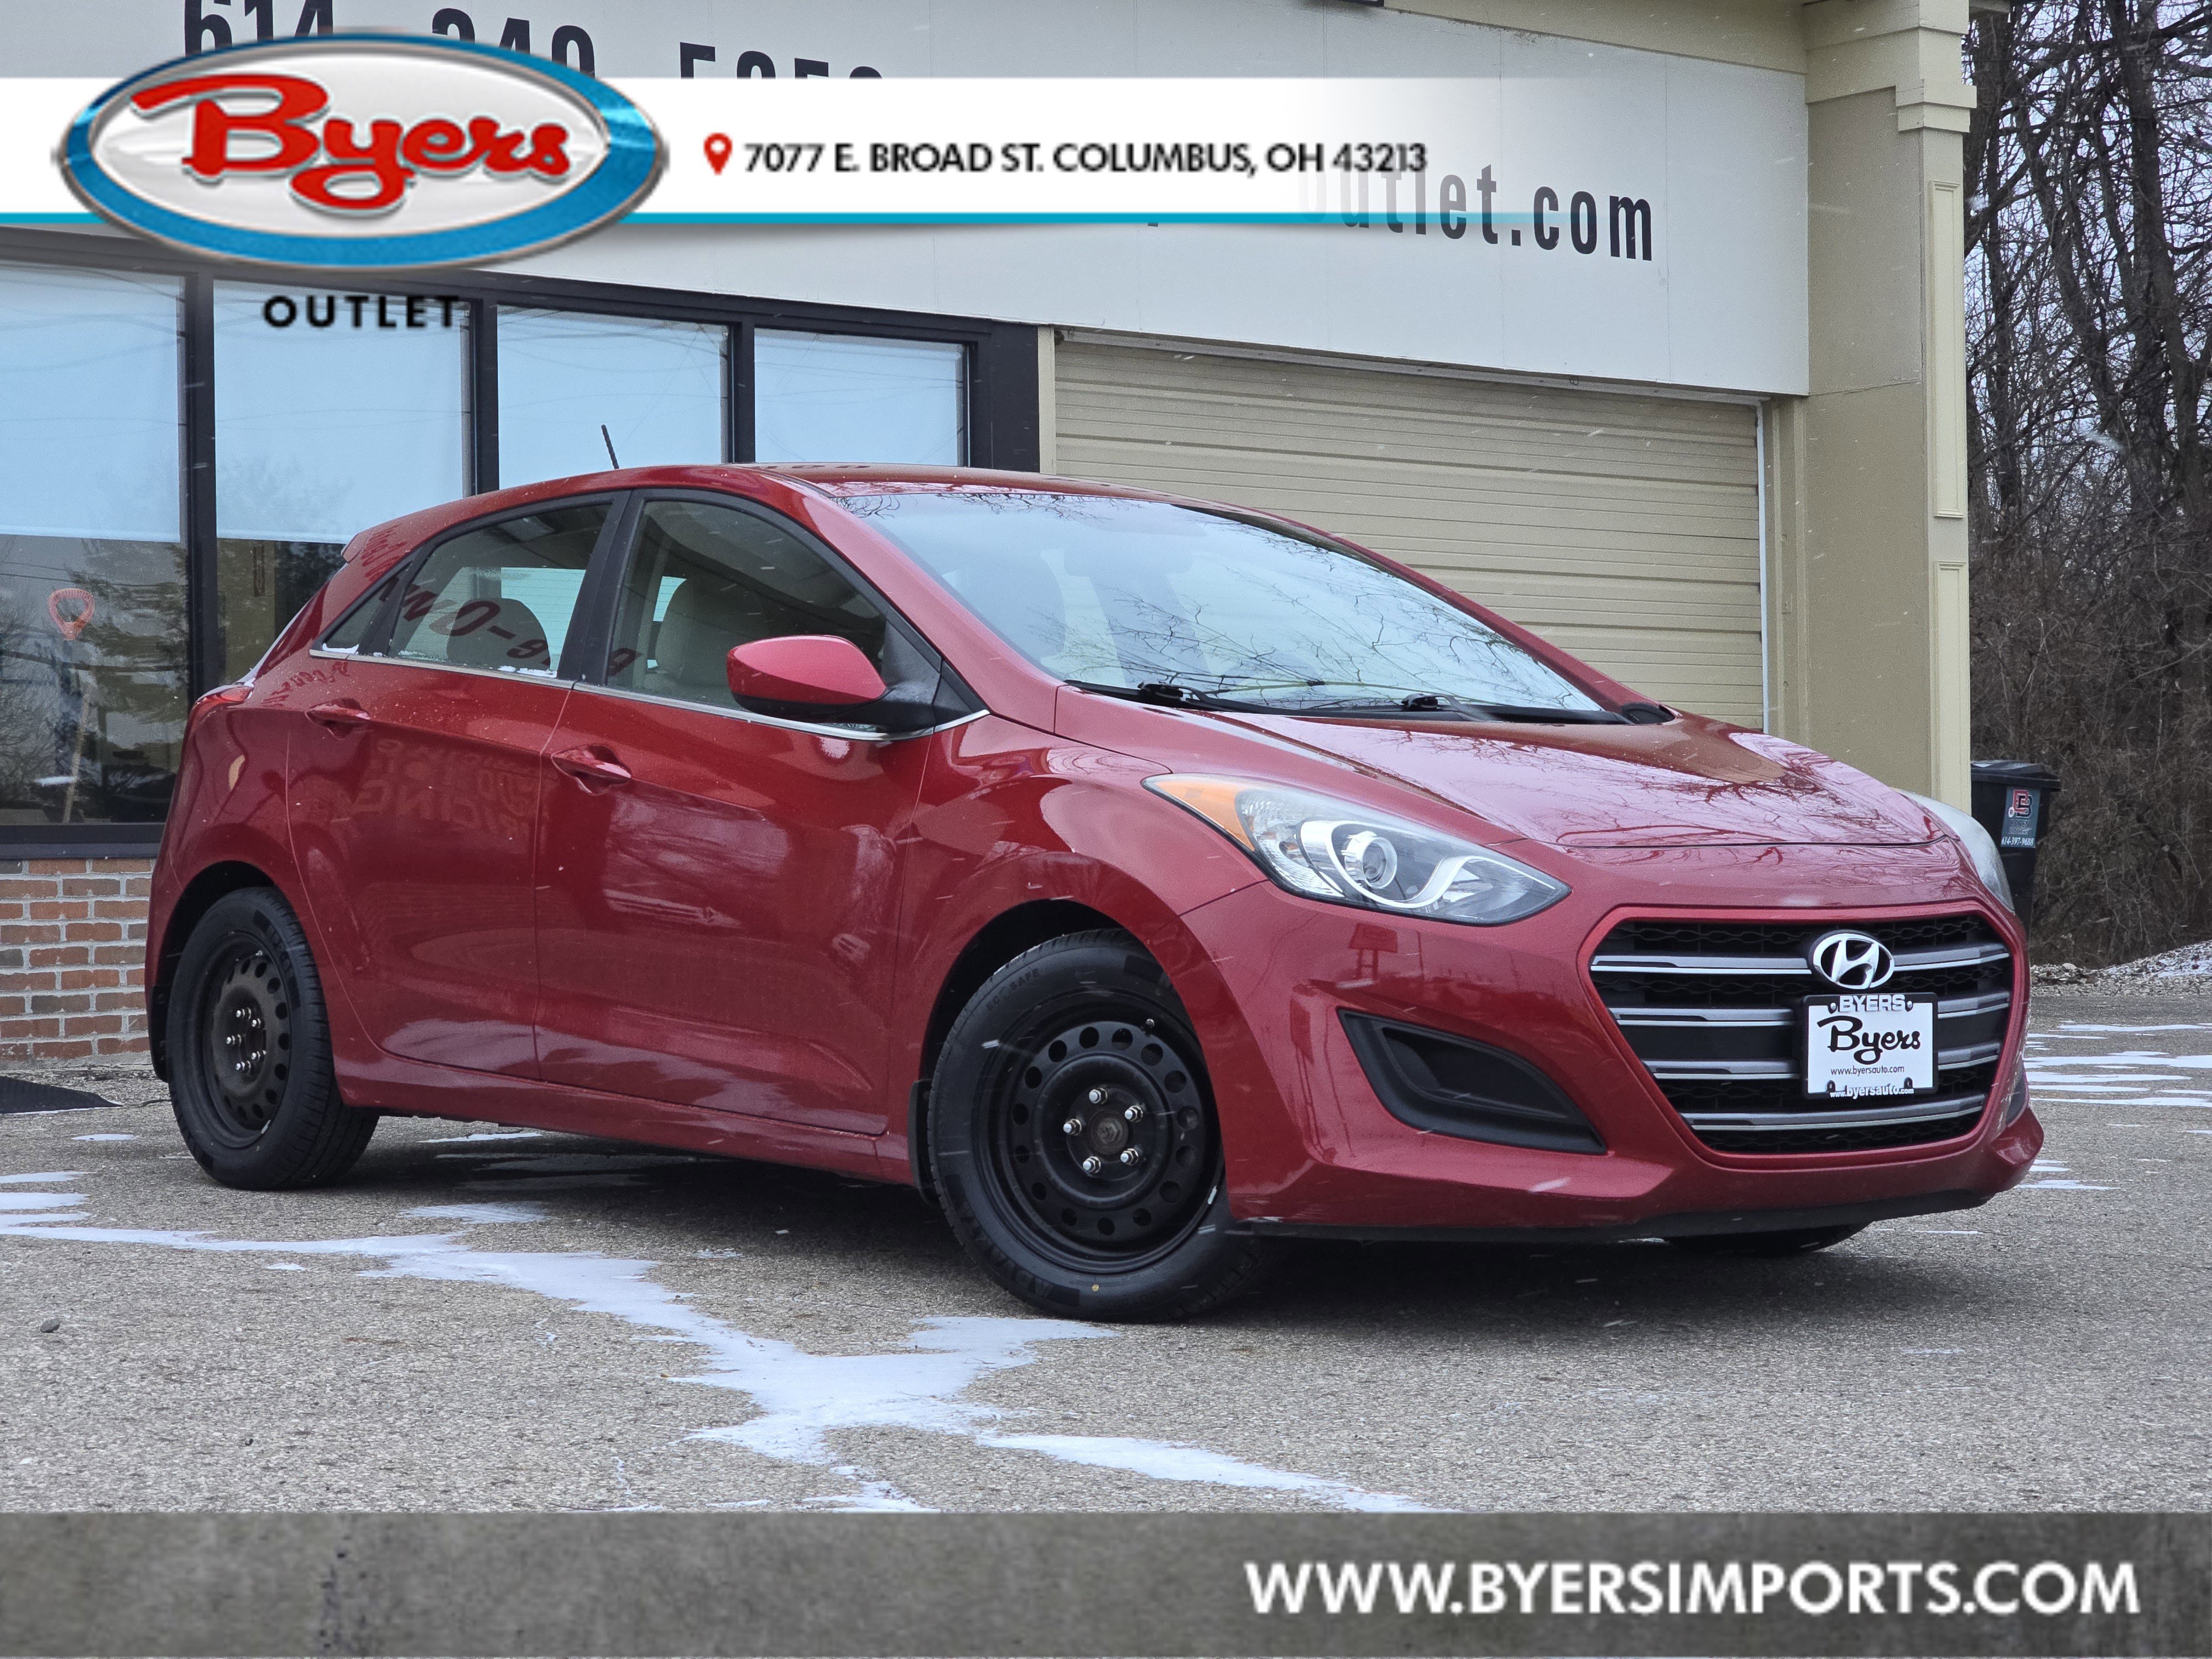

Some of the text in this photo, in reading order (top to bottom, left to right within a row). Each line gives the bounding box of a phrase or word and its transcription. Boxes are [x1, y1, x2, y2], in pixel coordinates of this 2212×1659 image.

[1839, 994, 1906, 1012] BYERS
[1817, 1015, 1921, 1065] Byers
[1830, 1065, 1905, 1077] www.byersauto.com
